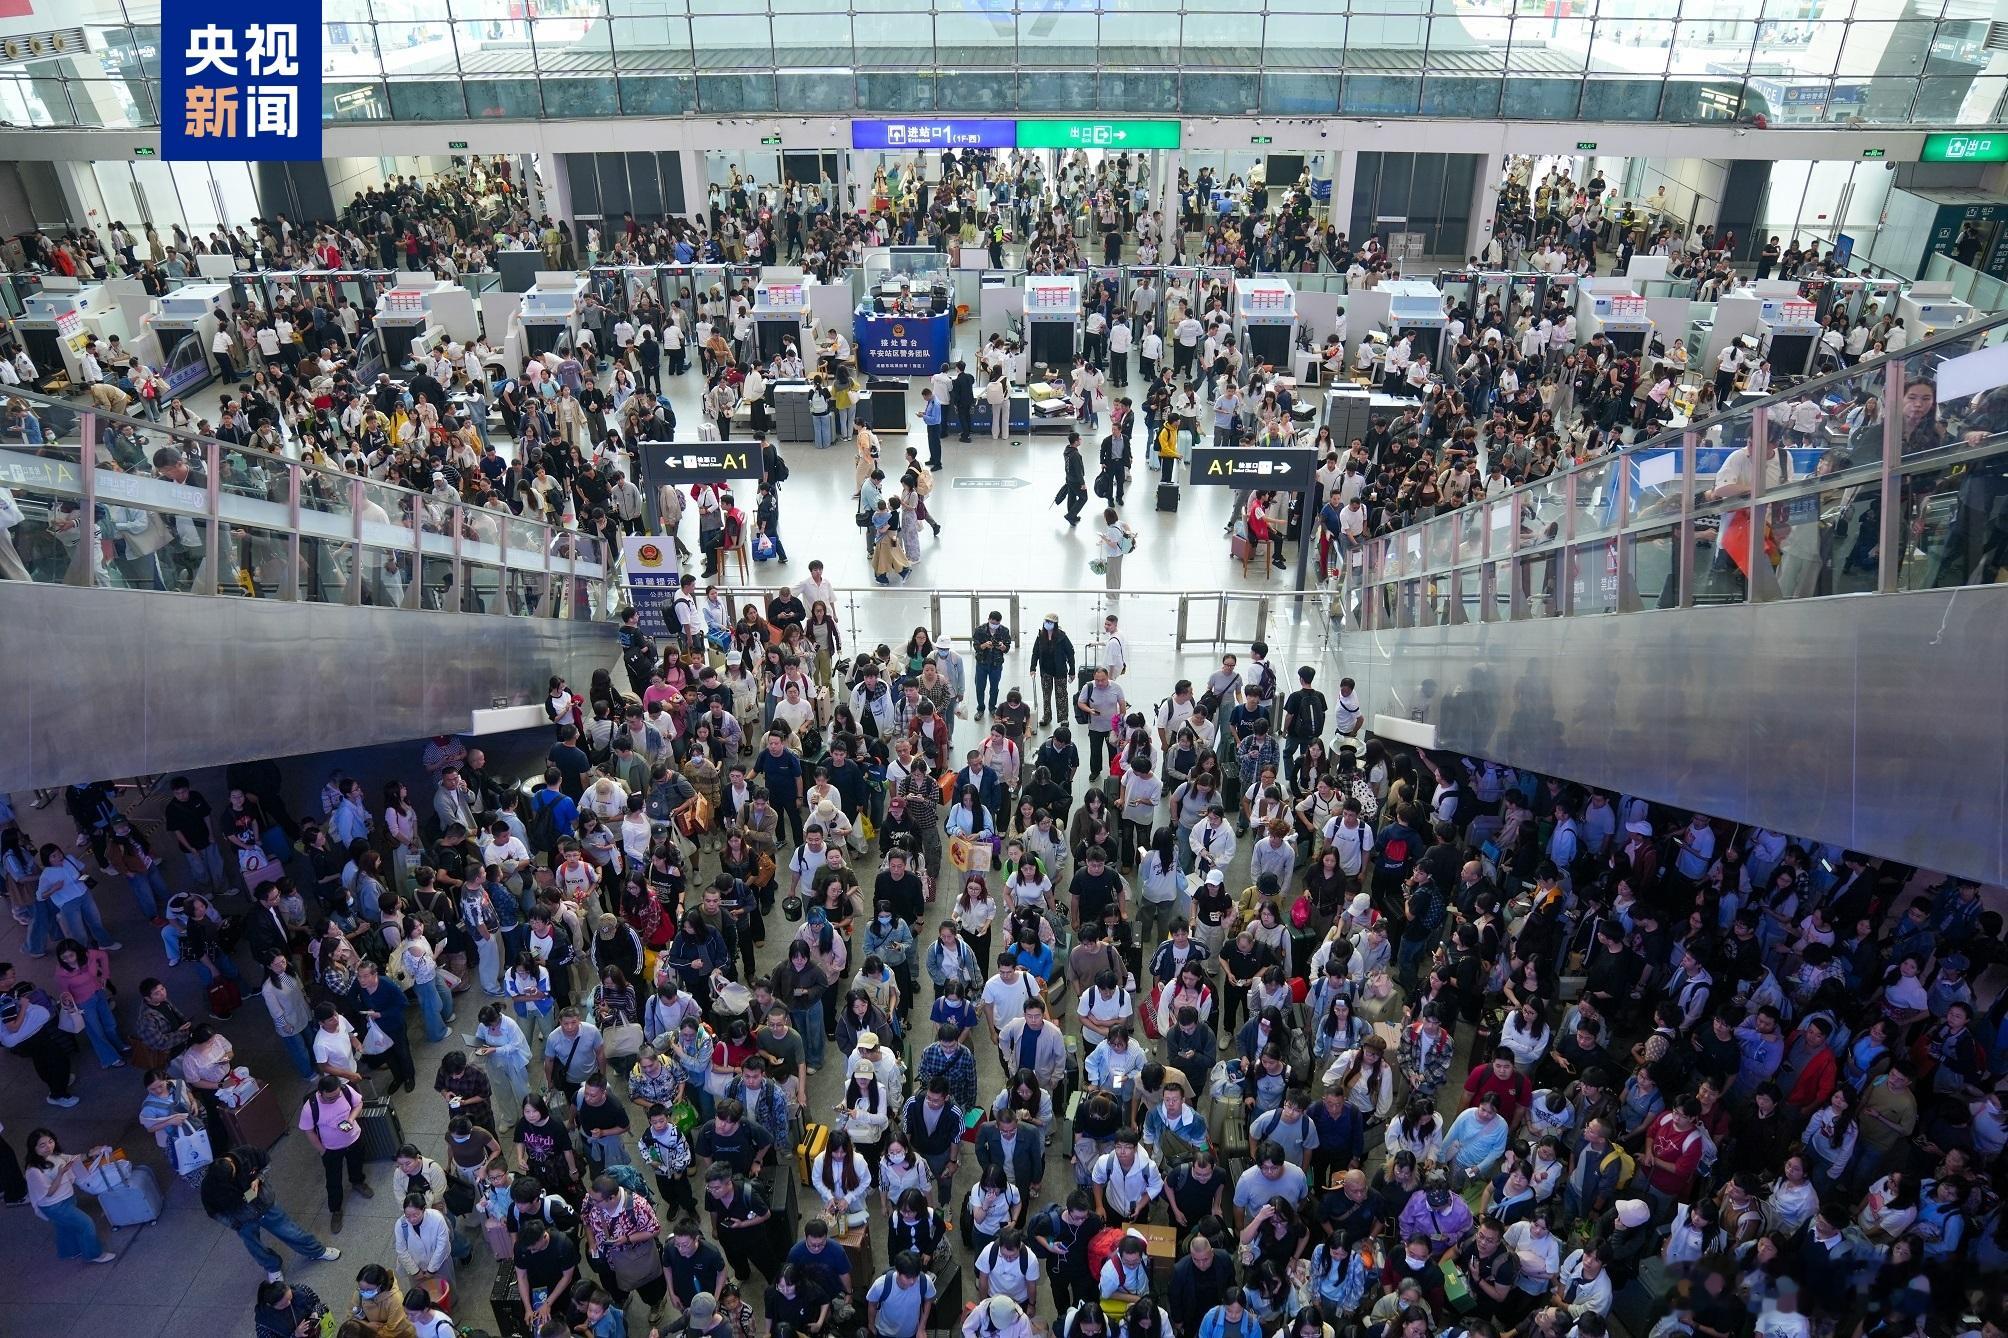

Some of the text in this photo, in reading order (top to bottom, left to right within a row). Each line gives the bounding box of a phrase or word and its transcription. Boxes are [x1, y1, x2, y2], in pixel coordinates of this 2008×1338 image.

[907, 126, 942, 138] 进站口
[1070, 126, 1091, 138] 出口
[1967, 140, 1991, 151] 出口
[880, 339, 918, 348] 接处警台
[869, 349, 931, 359] 平安站区警务团队
[722, 453, 748, 470] A1
[1207, 459, 1233, 476] A1
[634, 577, 677, 586] 温馨提示
